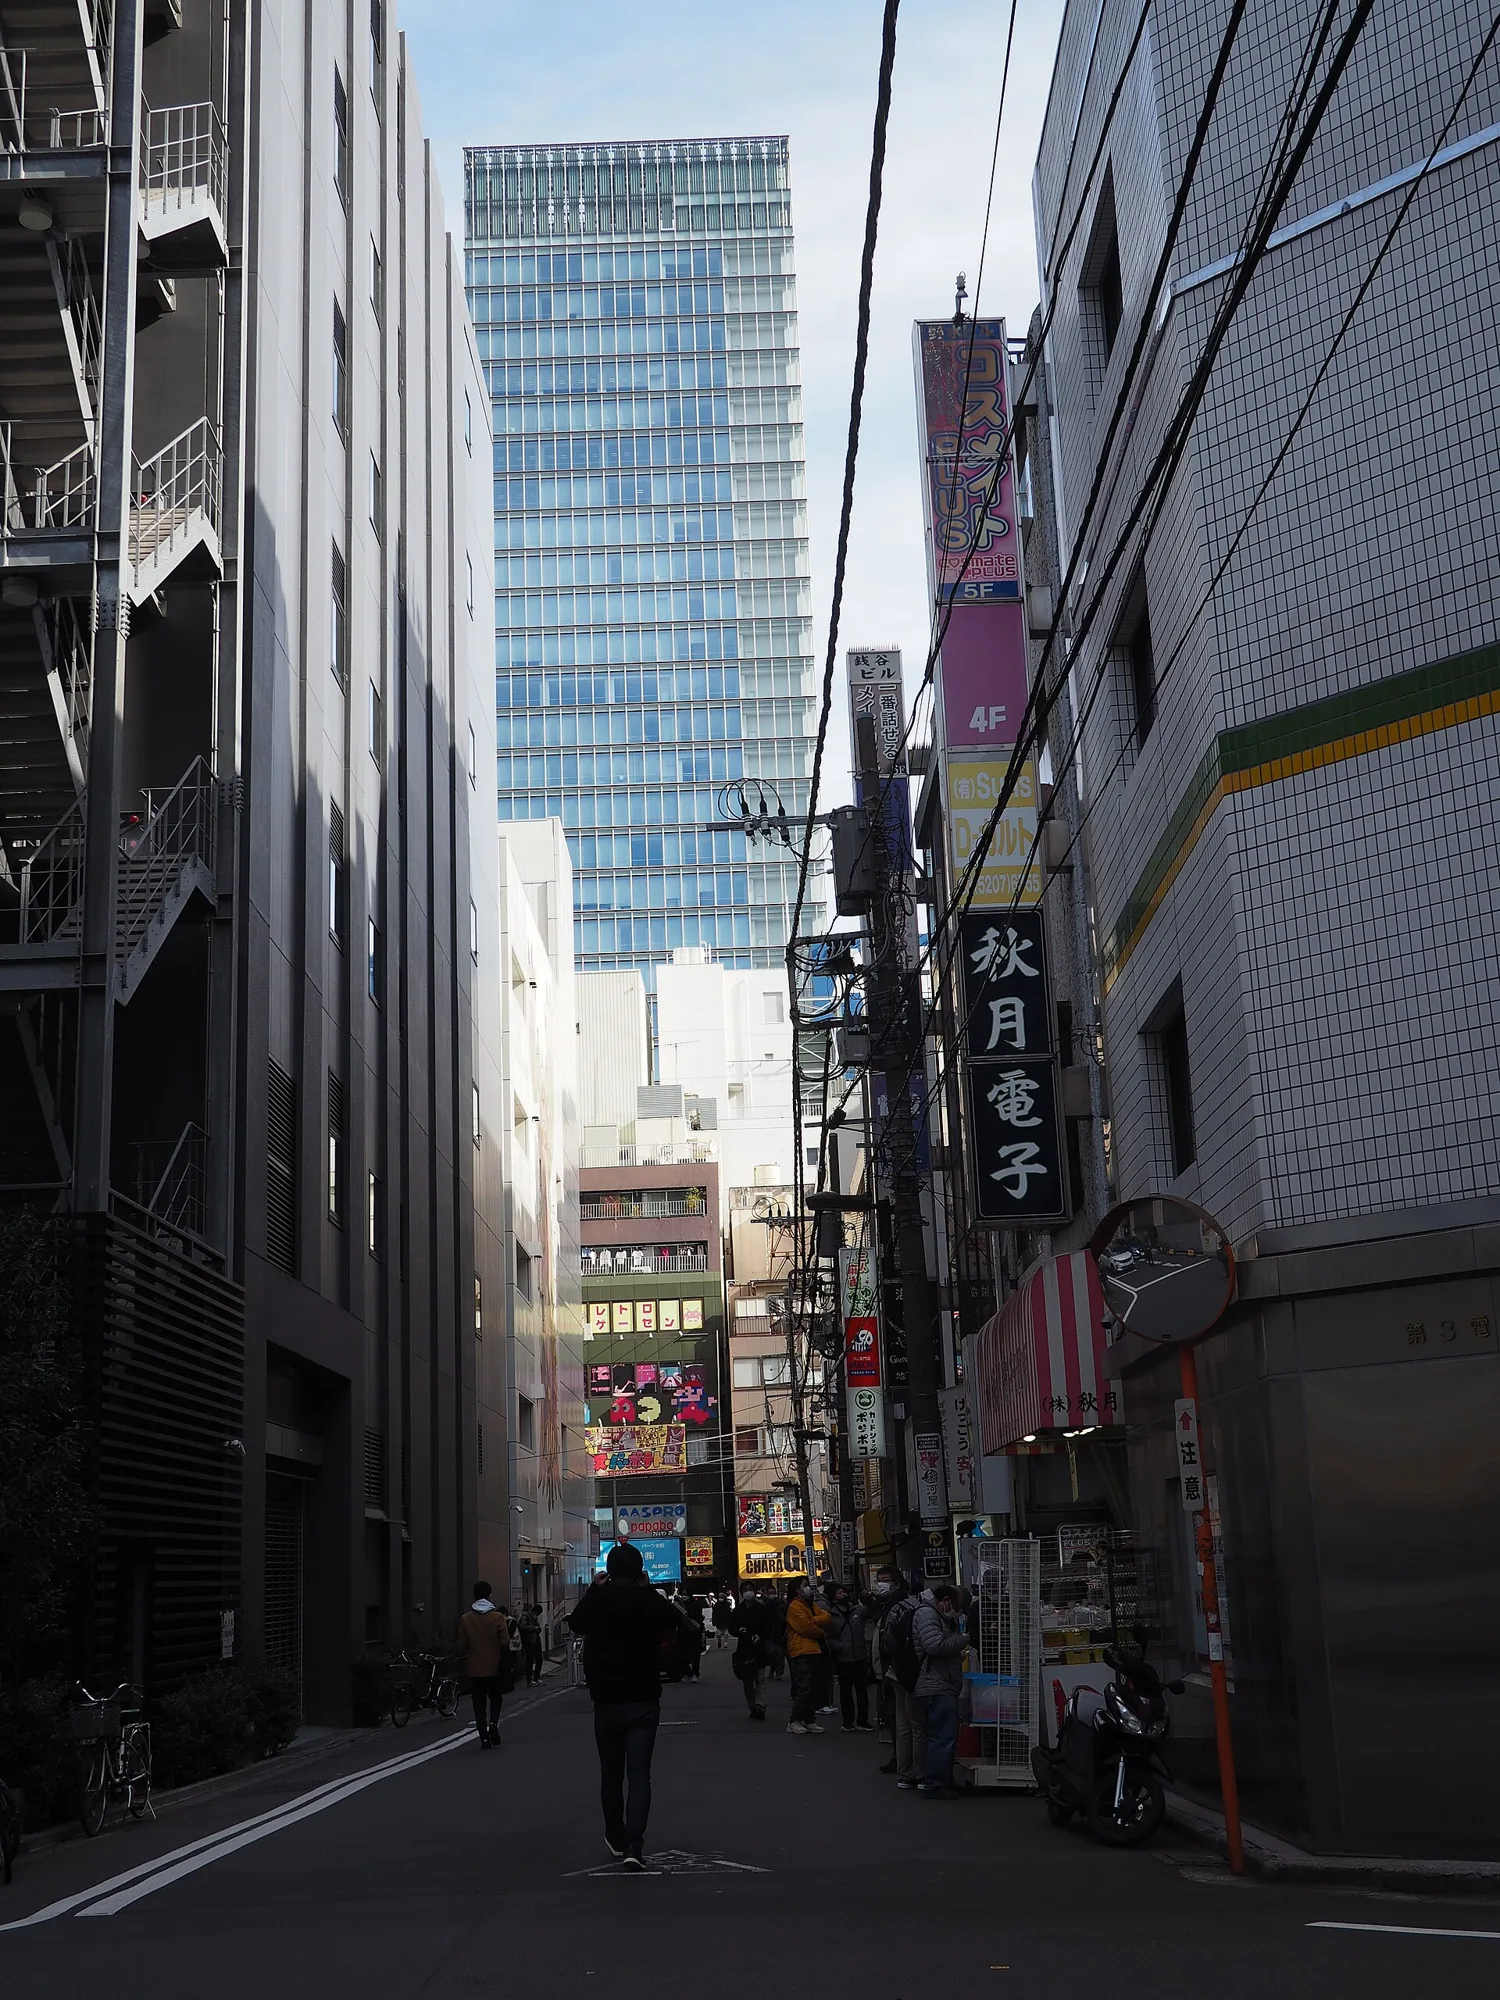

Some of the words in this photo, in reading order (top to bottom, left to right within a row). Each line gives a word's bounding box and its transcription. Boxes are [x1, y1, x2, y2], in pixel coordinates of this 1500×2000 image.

[956, 345, 1009, 551] コスメイト
[963, 583, 994, 599] 5F
[861, 668, 895, 680] ビル
[878, 684, 899, 760] 一番話せる
[969, 705, 1007, 733] 4F
[968, 926, 1048, 1200] 秋月電子
[596, 1304, 653, 1317] レトロ
[596, 1317, 674, 1329] ゲーセン
[1180, 1441, 1201, 1501] 注意
[618, 1505, 686, 1518] MASPRO
[631, 1520, 674, 1534] papabo
